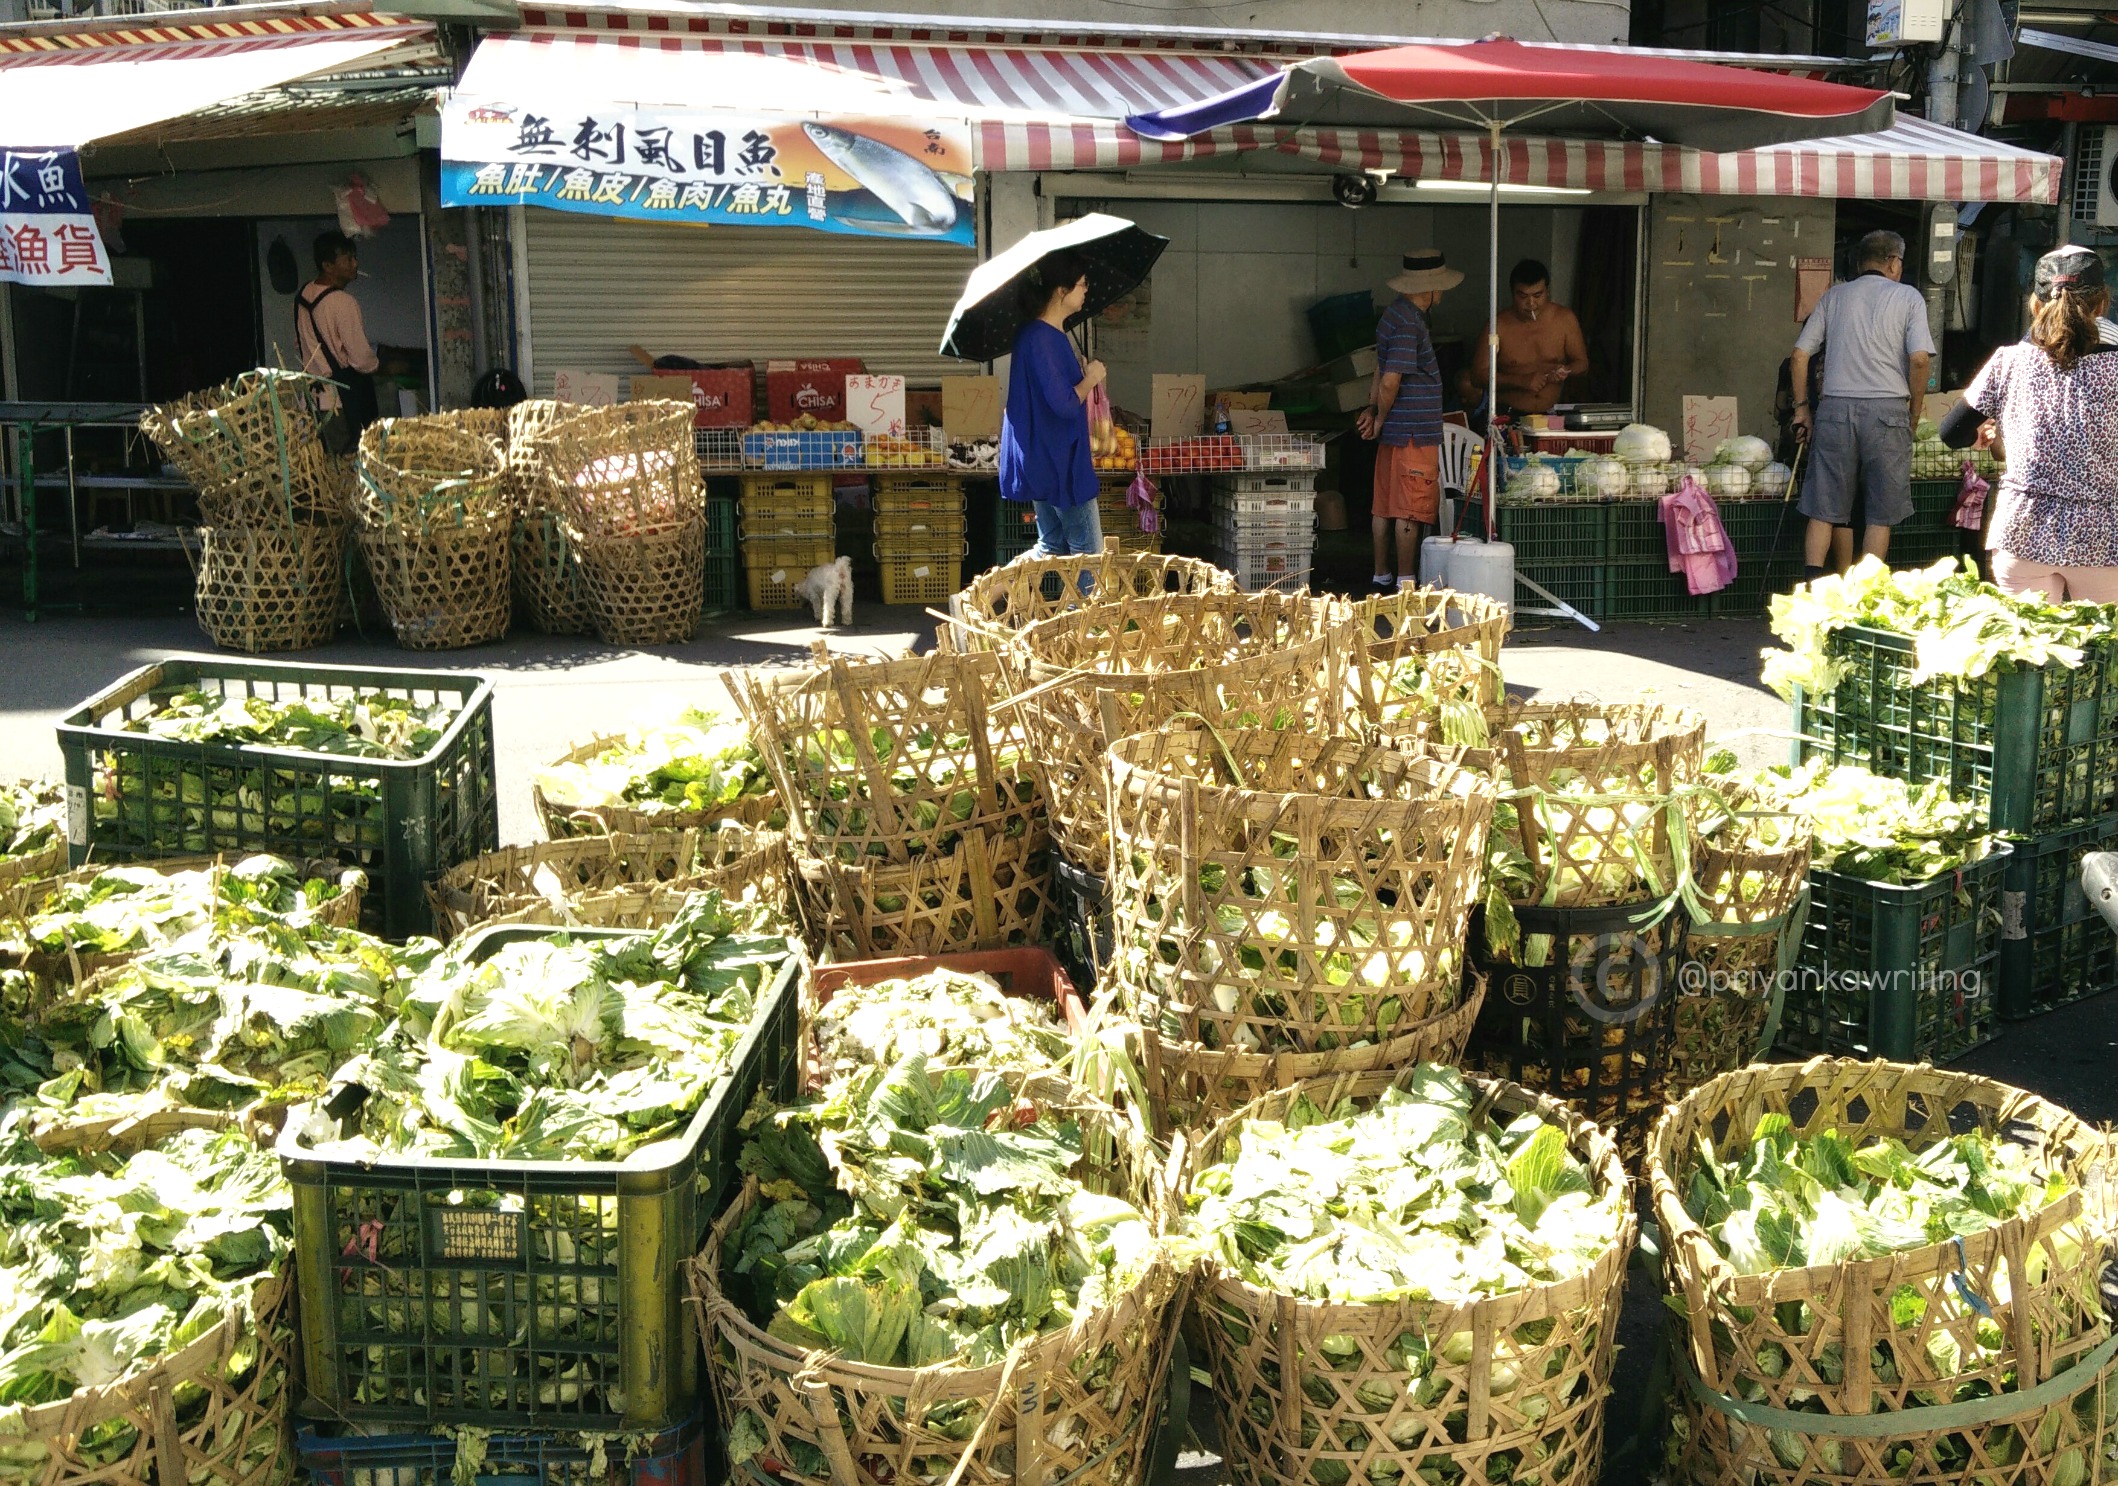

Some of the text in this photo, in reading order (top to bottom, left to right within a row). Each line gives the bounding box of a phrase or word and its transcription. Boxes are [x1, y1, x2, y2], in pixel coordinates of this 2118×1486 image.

[506, 113, 782, 177] 無刺虱目魚
[799, 396, 835, 407] CHISA
